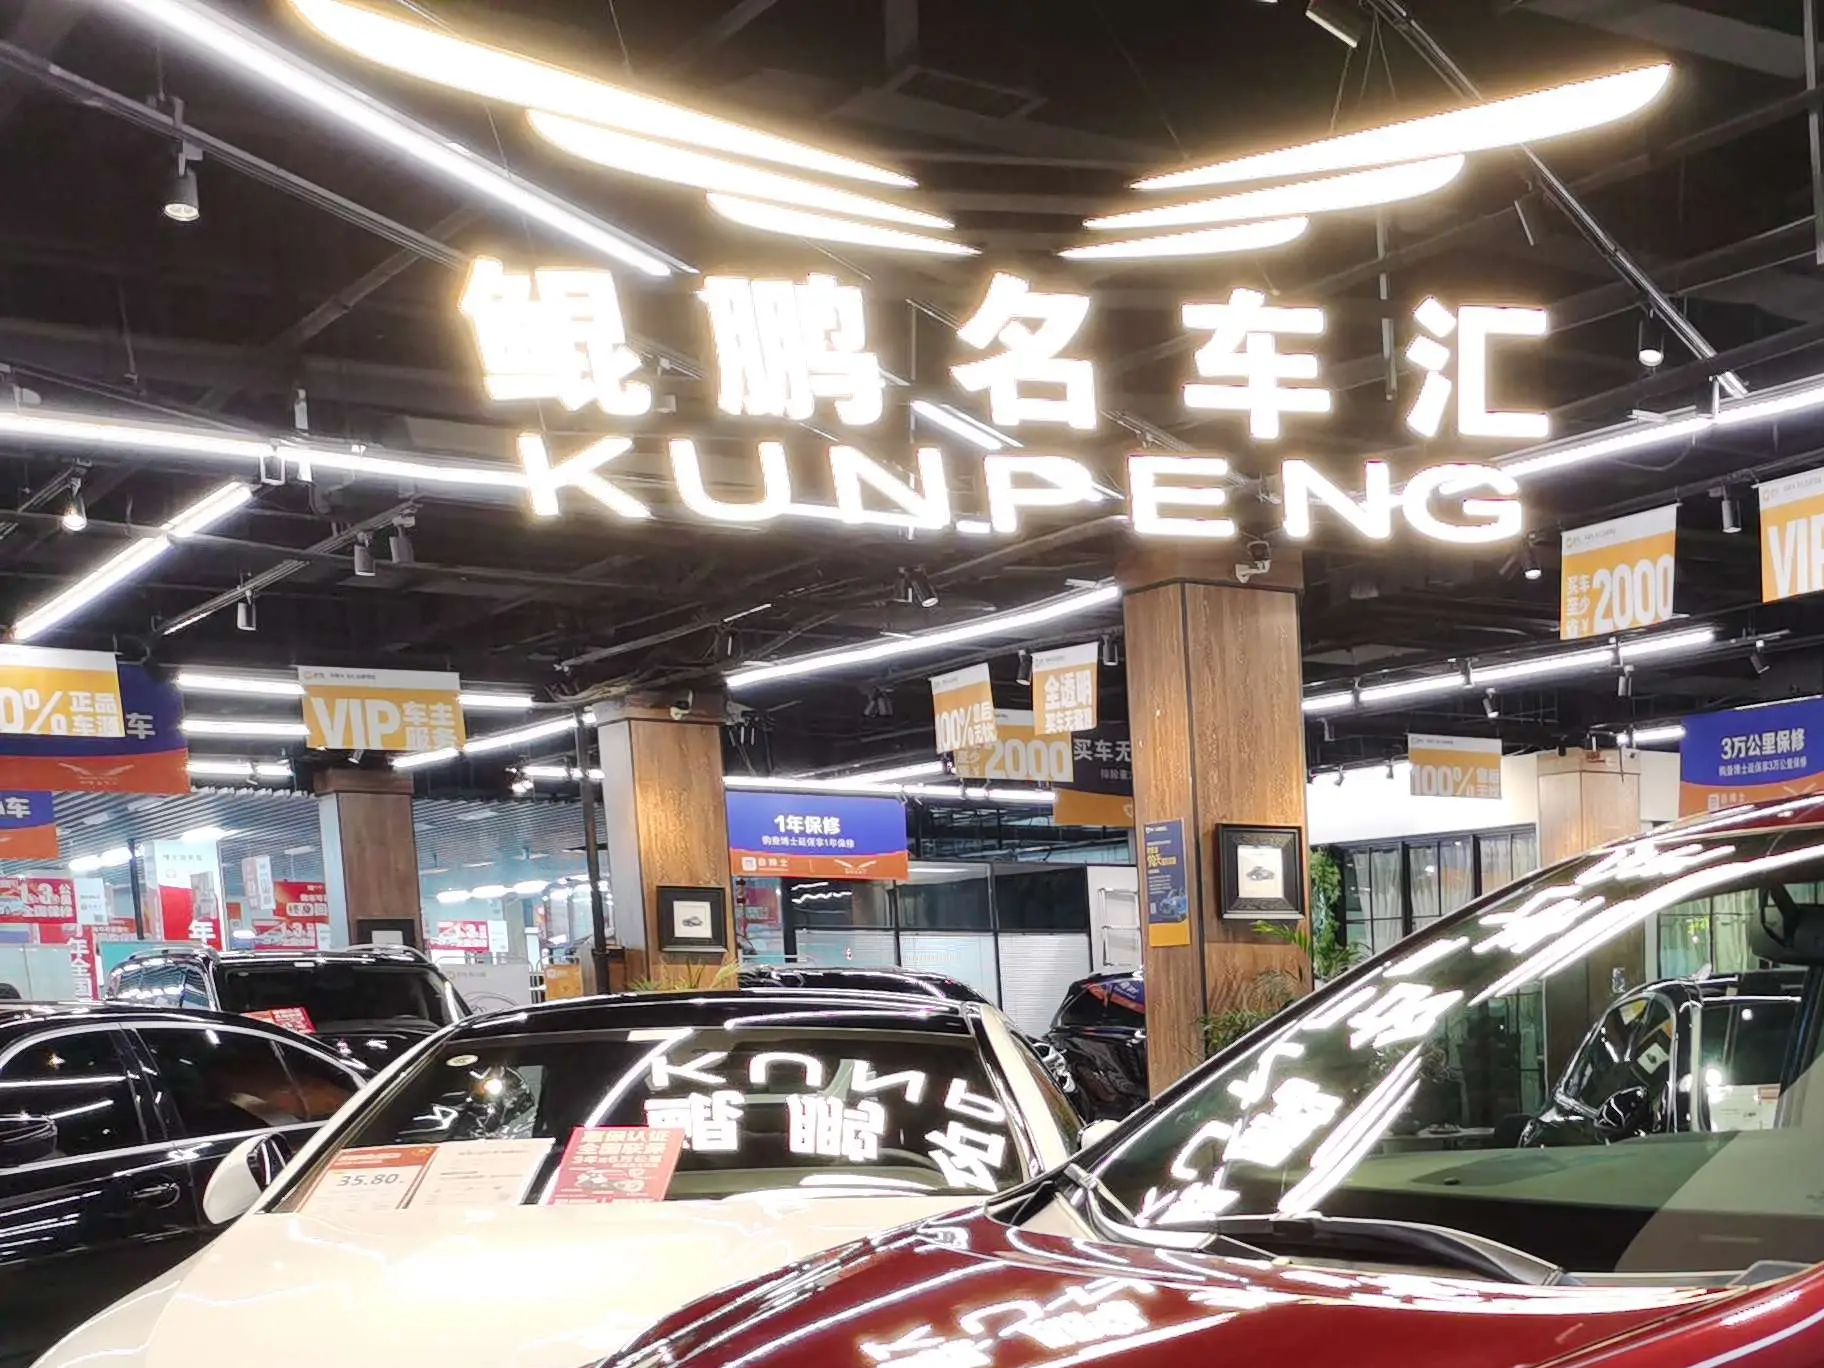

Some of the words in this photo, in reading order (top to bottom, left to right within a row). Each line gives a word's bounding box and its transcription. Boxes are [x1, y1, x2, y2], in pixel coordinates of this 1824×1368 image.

[457, 254, 1554, 440] 鲲鹏名车汇
[514, 431, 1528, 544] KUNPENG
[1592, 554, 1675, 634] 2000
[69, 690, 118, 713] 正品
[401, 701, 456, 726] 车主
[126, 712, 156, 740] 车
[311, 697, 401, 750] VIP
[985, 738, 1070, 780] 2000
[1720, 727, 1806, 760] 3万公里保修
[1410, 764, 1475, 797] 100%
[773, 814, 841, 836] 1年保修
[336, 1173, 400, 1187] 35.80
